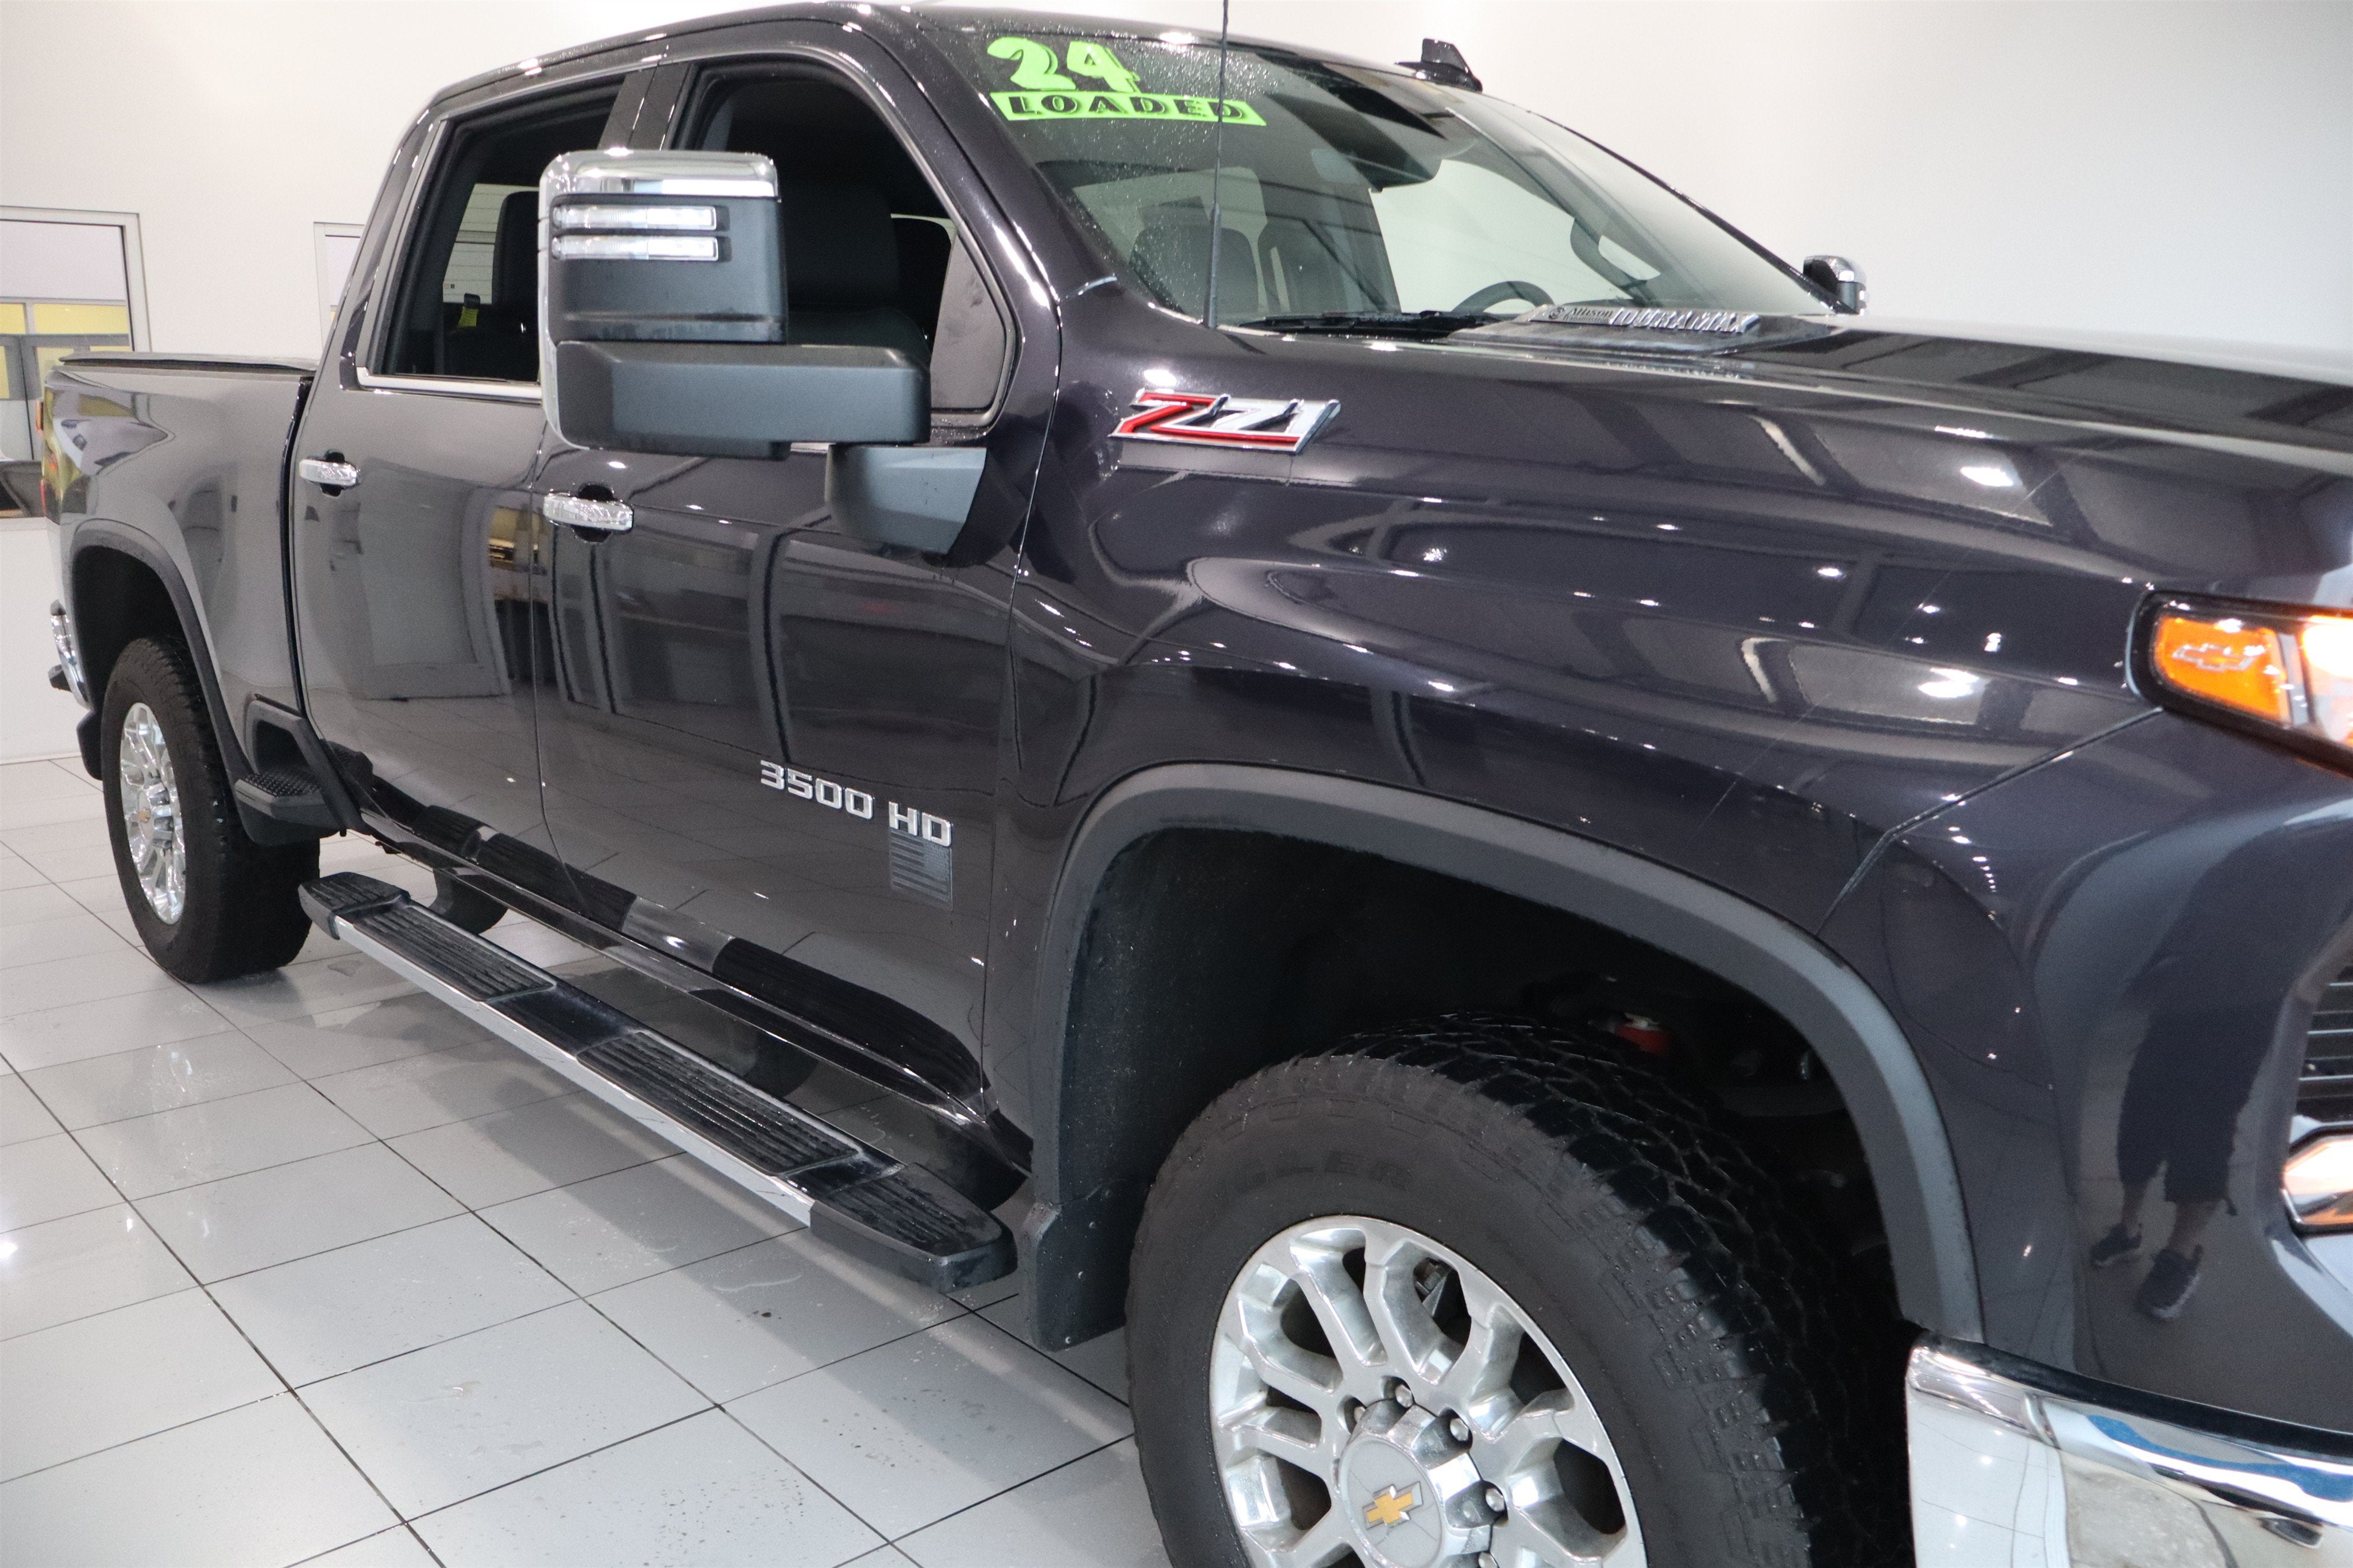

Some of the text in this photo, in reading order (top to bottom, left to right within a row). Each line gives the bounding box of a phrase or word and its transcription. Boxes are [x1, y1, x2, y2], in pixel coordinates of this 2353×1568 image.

[987, 36, 1140, 94] 24
[1009, 95, 1246, 119] LOADED
[1108, 388, 1341, 454] Z71
[760, 760, 954, 847] 3500 HD
